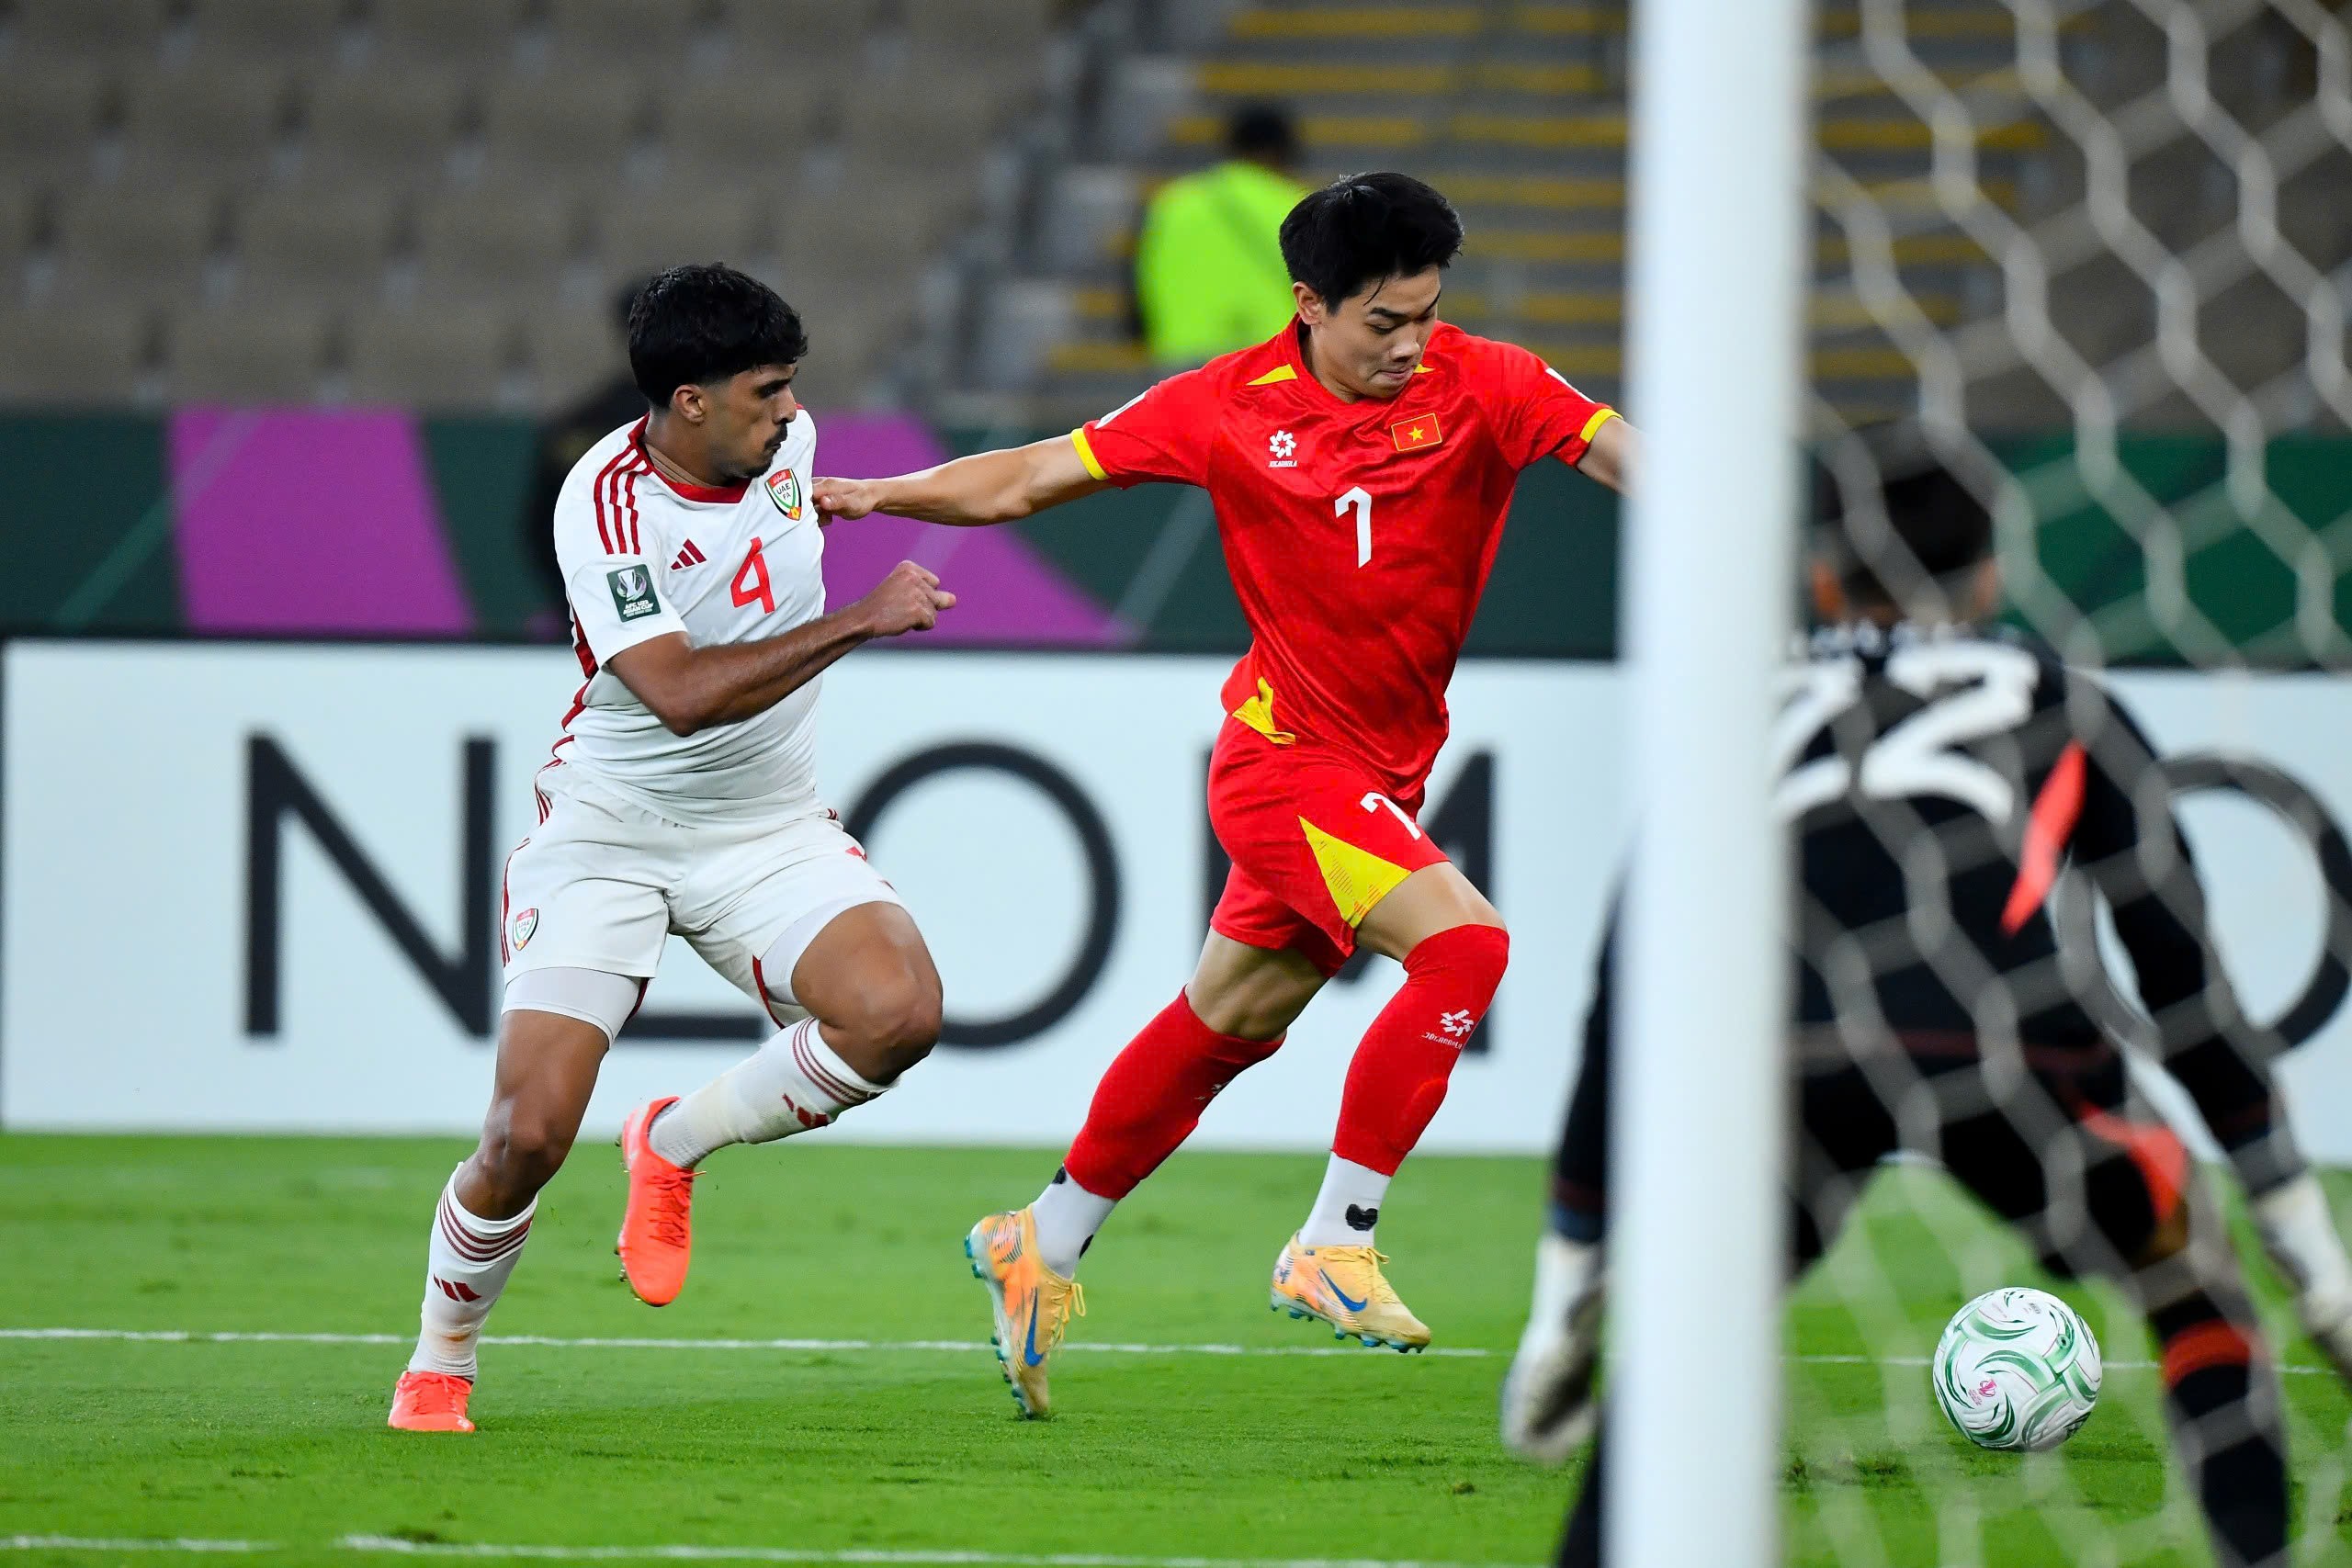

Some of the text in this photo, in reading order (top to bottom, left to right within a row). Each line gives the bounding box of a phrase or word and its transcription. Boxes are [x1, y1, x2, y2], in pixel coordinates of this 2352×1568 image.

[775, 482, 791, 495] UAE
[1334, 485, 1373, 570] 7
[730, 536, 775, 615] 4
[1360, 792, 1421, 840] 7
